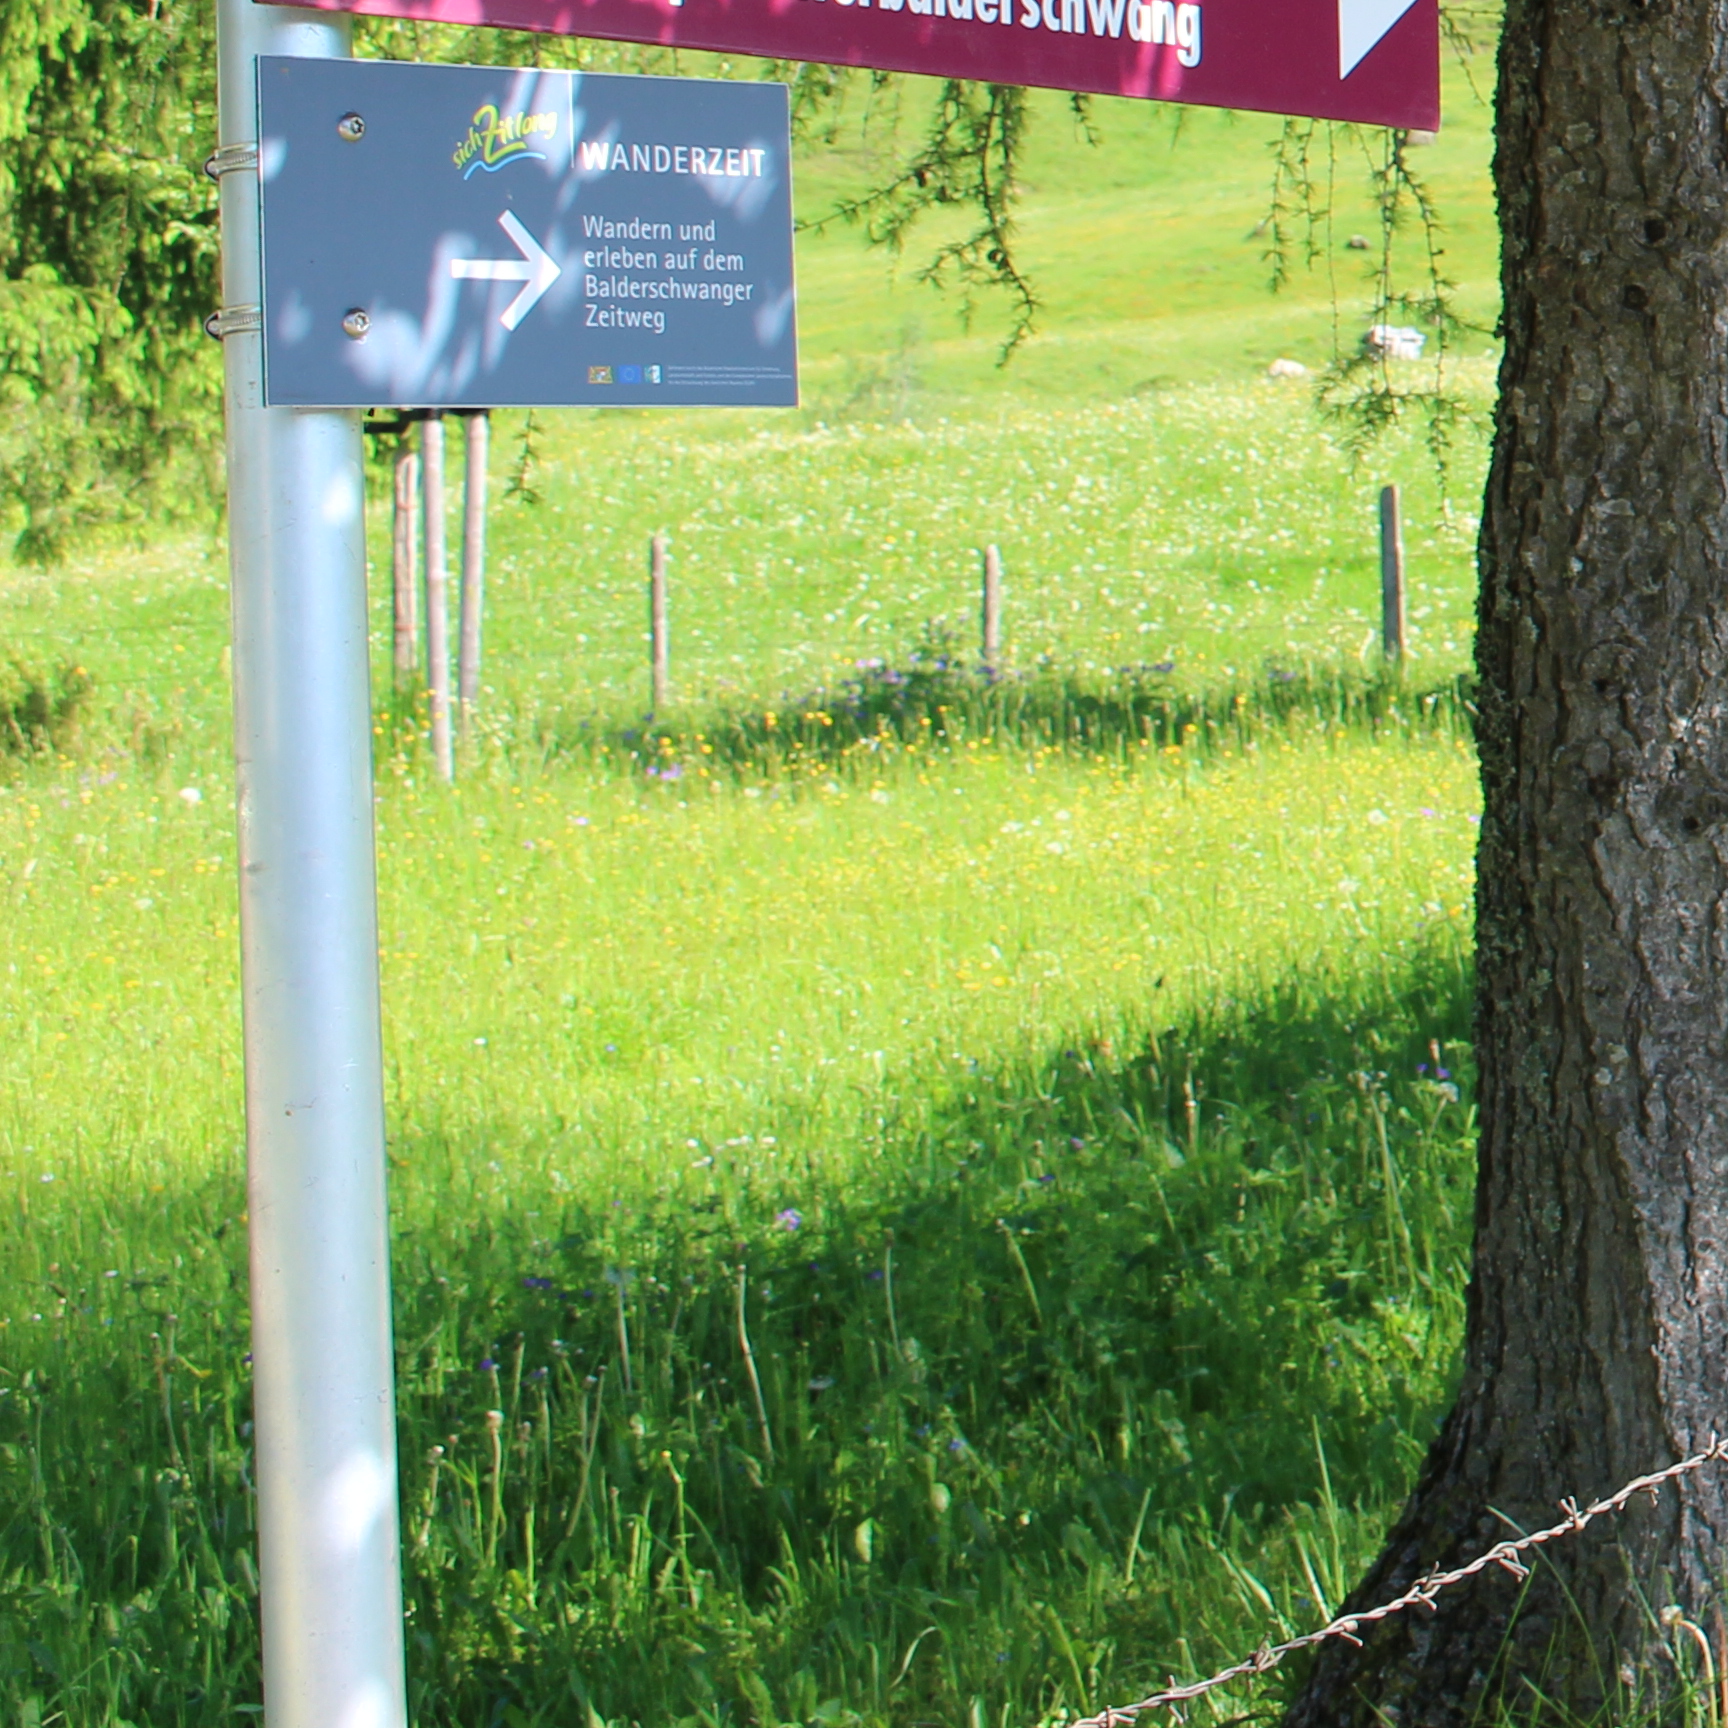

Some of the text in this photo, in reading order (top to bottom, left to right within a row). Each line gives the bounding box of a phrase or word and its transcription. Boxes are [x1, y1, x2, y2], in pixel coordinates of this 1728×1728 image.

[452, 126, 483, 170] sich
[580, 141, 765, 178] WANDERZEIT
[582, 214, 717, 242] Wandern und
[584, 245, 745, 272] erleben auf dem
[585, 273, 754, 307] Balderschwanger
[585, 303, 667, 335] Zeitweg
